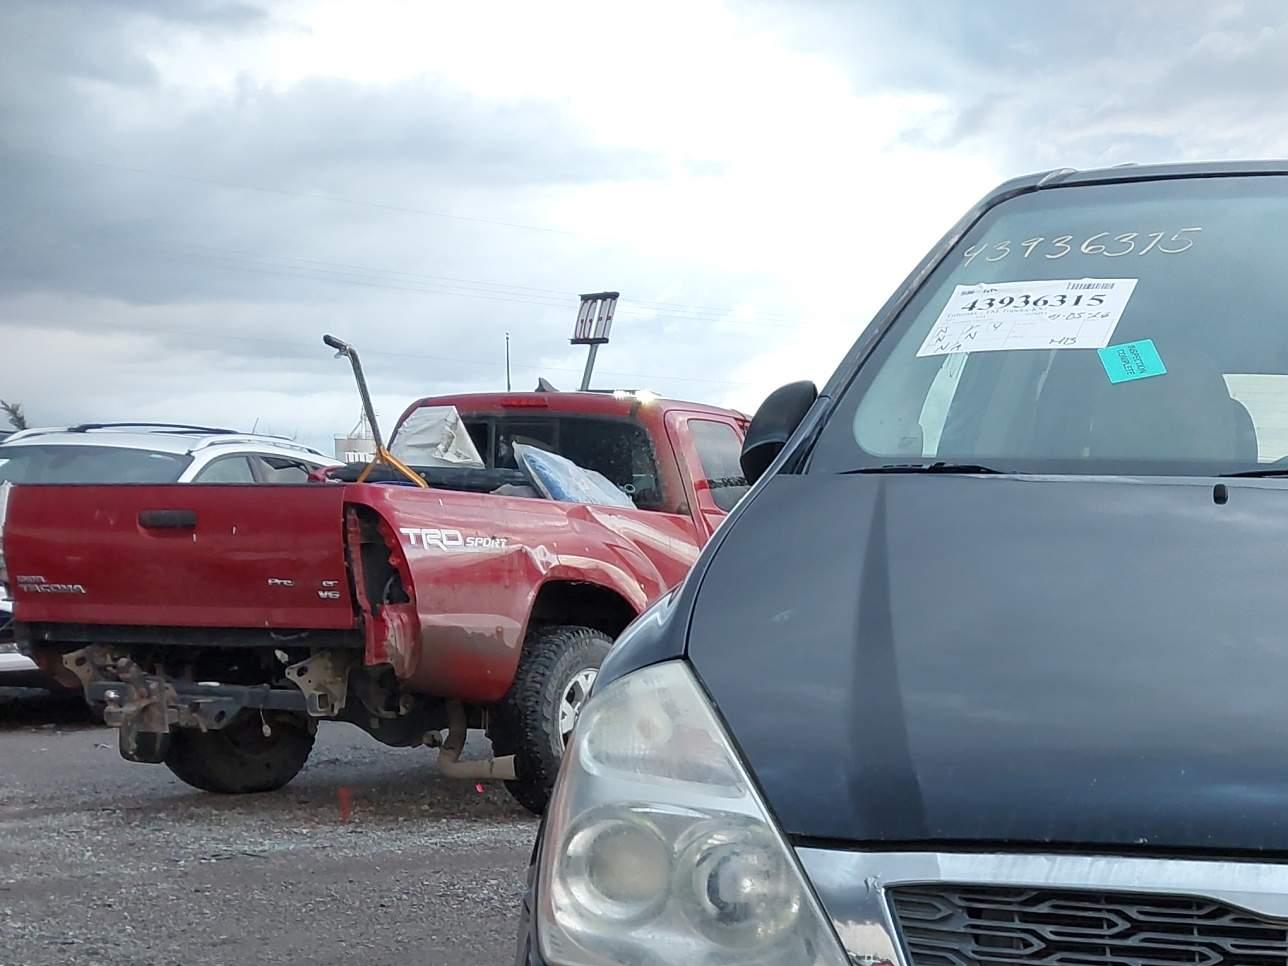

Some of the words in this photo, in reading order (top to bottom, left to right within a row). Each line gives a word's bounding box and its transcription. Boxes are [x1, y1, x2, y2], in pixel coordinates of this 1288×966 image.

[964, 227, 1202, 267] 43936315
[961, 294, 1106, 311] 43936315
[1117, 348, 1136, 376] COMPLETE
[399, 527, 464, 553] TRD
[465, 536, 508, 548] SPORT
[317, 590, 341, 599] V6
